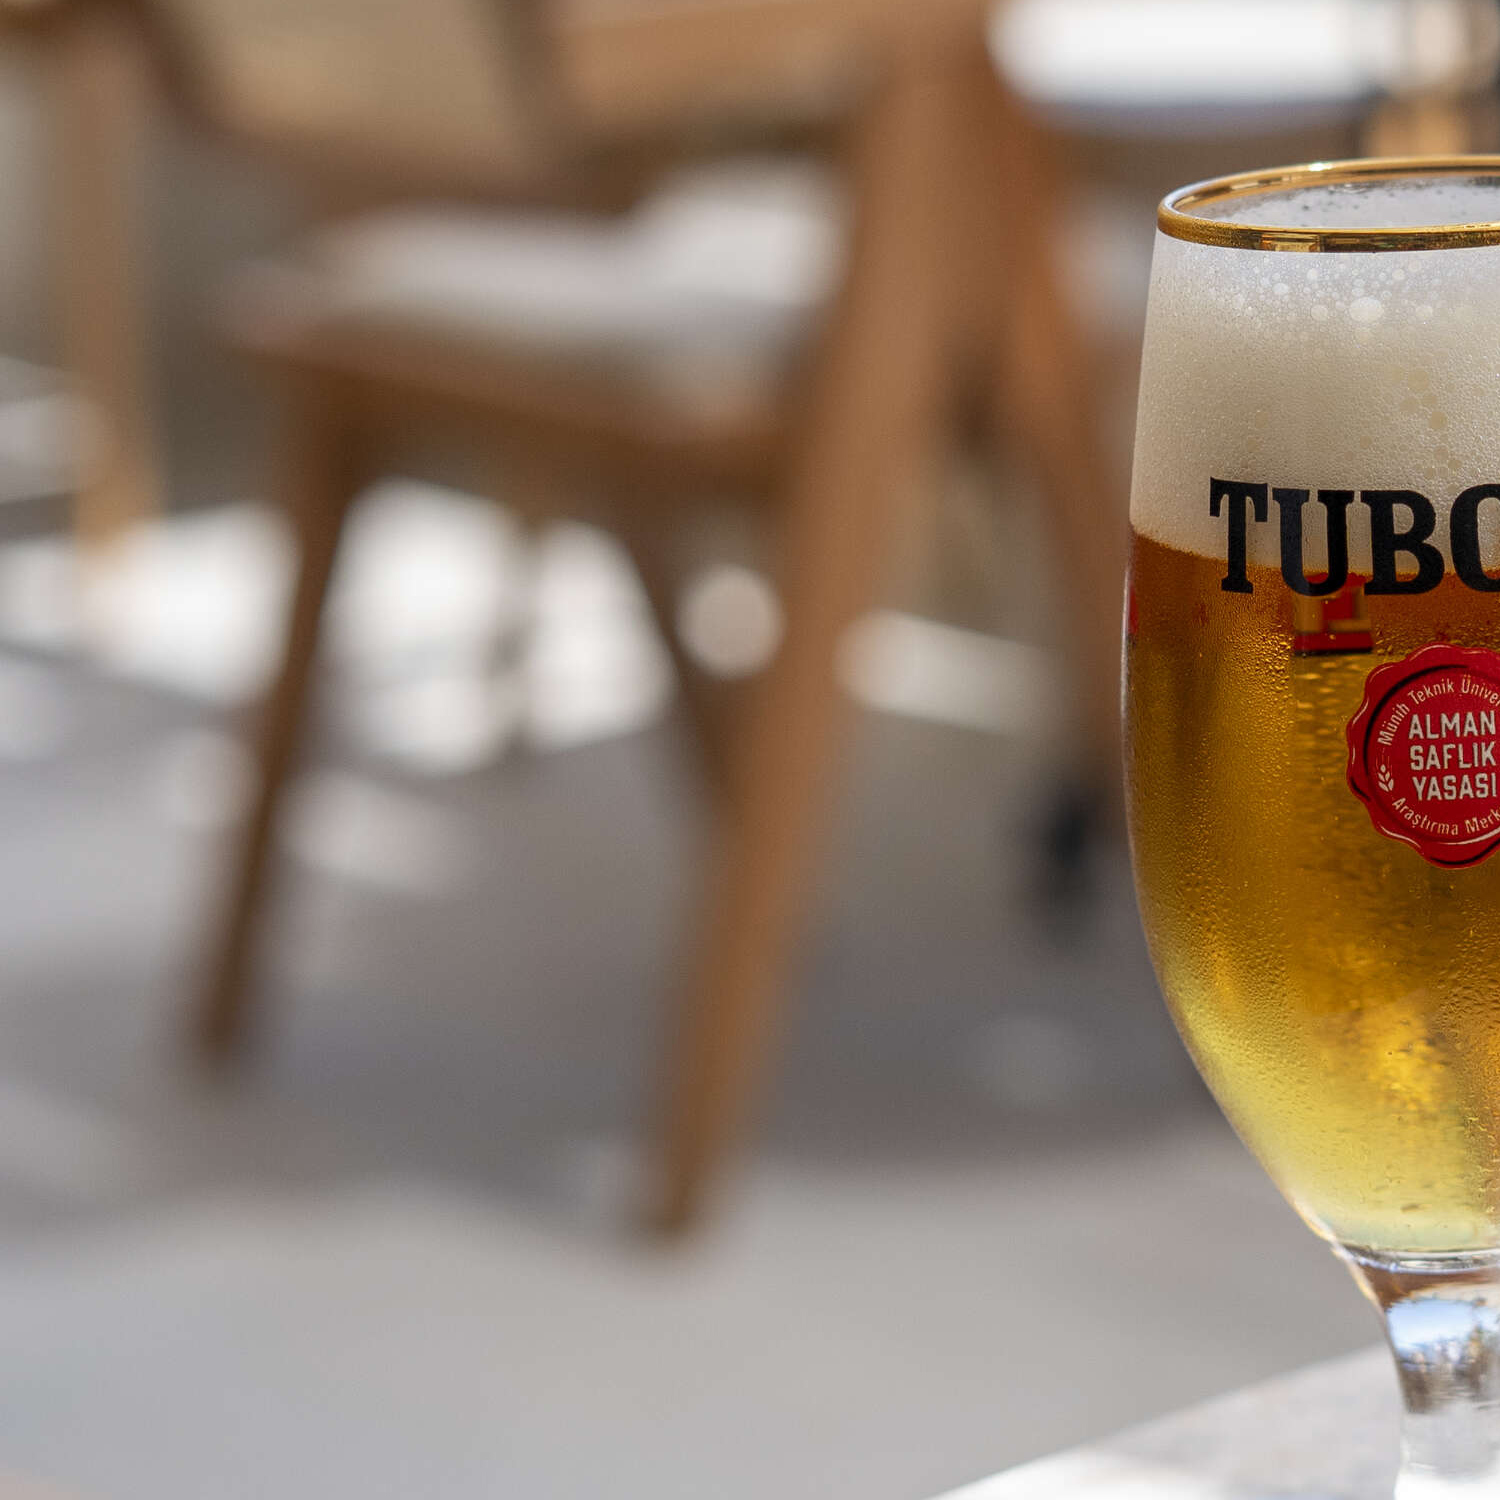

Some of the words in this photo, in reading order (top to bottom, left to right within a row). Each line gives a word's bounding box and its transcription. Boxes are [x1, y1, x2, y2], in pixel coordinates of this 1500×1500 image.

[1377, 702, 1410, 745] Münih
[1408, 678, 1454, 705] Teknik
[1408, 710, 1496, 740] ALMAN
[1409, 741, 1496, 771] SAFLIK
[1411, 772, 1497, 801] YASASI
[1392, 797, 1459, 835] Araştırma
